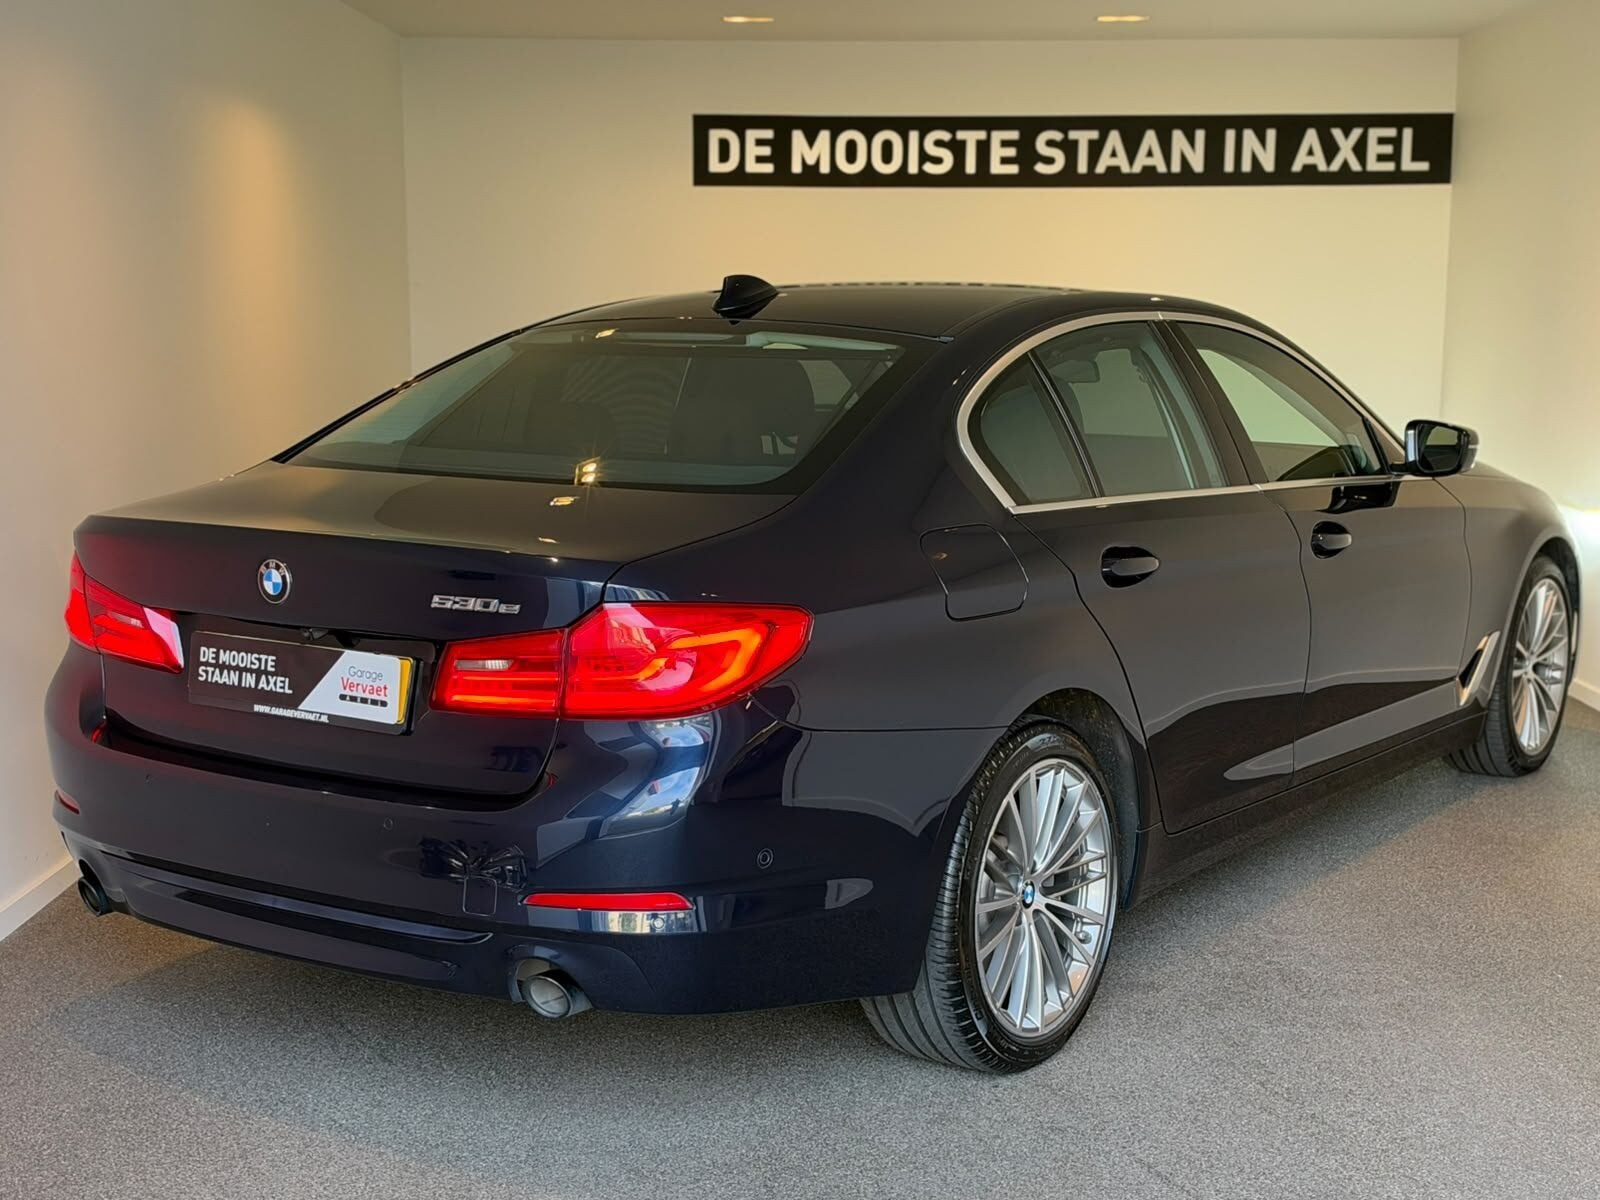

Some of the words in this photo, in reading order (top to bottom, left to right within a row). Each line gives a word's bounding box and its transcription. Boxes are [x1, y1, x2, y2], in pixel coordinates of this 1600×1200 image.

[709, 129, 774, 173] DE
[791, 130, 1019, 174] MOOISTE
[1034, 130, 1205, 174] STAAN
[1224, 129, 1276, 172] IN
[1292, 128, 1429, 172] AXEL
[200, 647, 216, 663] DE
[219, 649, 276, 671] MOOISTE
[198, 666, 239, 686] STAAN
[242, 672, 256, 688] IN
[257, 674, 293, 694] AXEL
[349, 666, 383, 682] Garage
[341, 677, 388, 697] Vervaet
